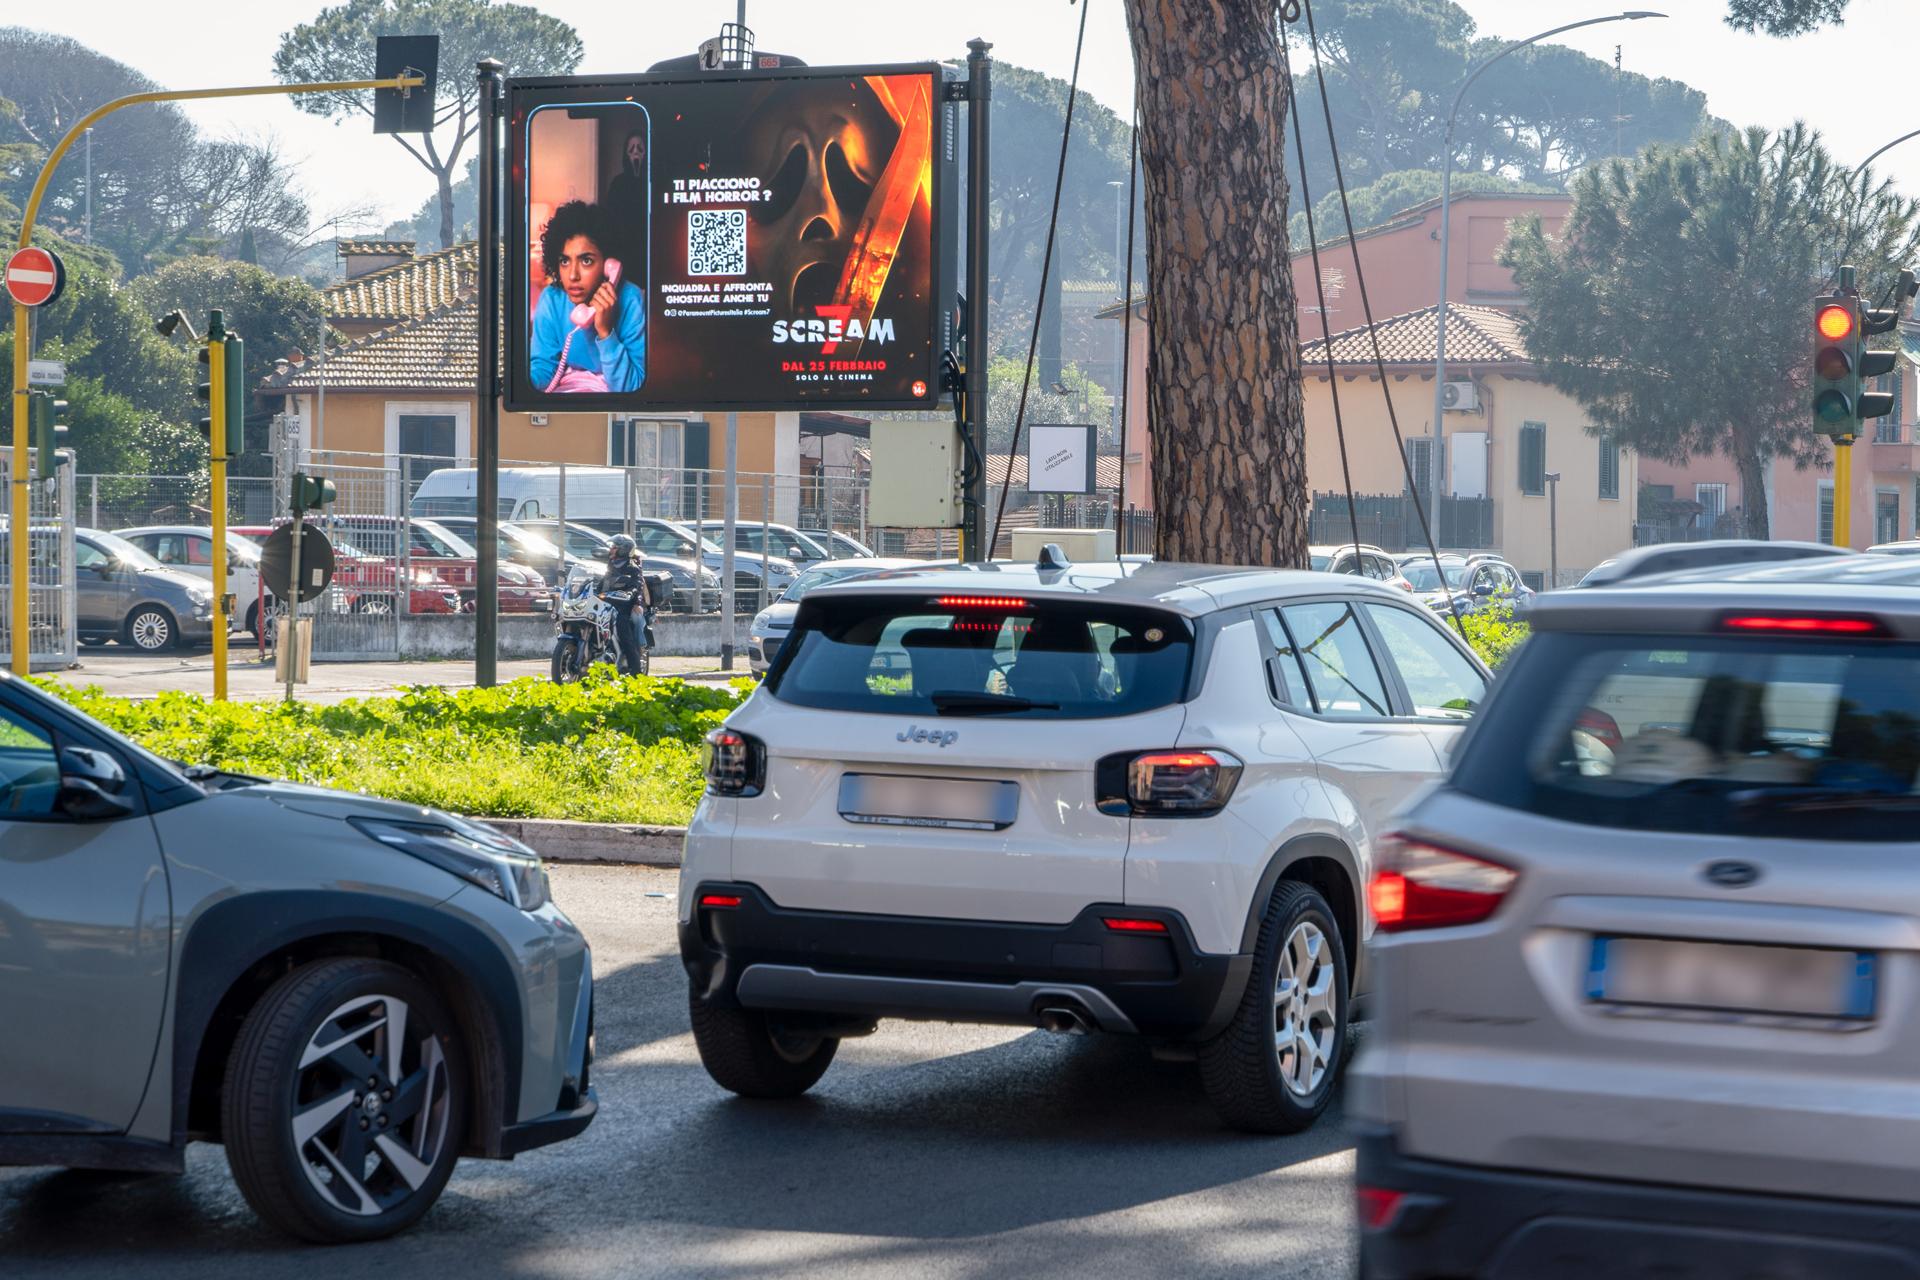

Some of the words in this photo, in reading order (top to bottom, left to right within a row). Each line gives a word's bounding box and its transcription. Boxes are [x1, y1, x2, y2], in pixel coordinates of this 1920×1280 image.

[673, 180, 685, 191] TI
[688, 177, 760, 190] PIACCIONO
[664, 192, 669, 203] I
[673, 192, 701, 205] FILM
[705, 190, 760, 203] HORROR
[762, 189, 772, 202] ?
[661, 284, 711, 293] INQUADRA
[713, 284, 720, 292] E
[723, 282, 773, 292] AFFRONTA
[666, 294, 720, 304] GHOSTFACE
[723, 294, 754, 303] ANCHE
[757, 294, 769, 302] TU
[744, 308, 771, 316] #Scream7
[772, 319, 896, 346] SCREAM
[782, 361, 804, 372] DAL
[809, 361, 825, 371] 25
[829, 360, 887, 371] FEBBRAIO
[1045, 454, 1056, 464] LATO
[896, 724, 959, 748] Jeep
